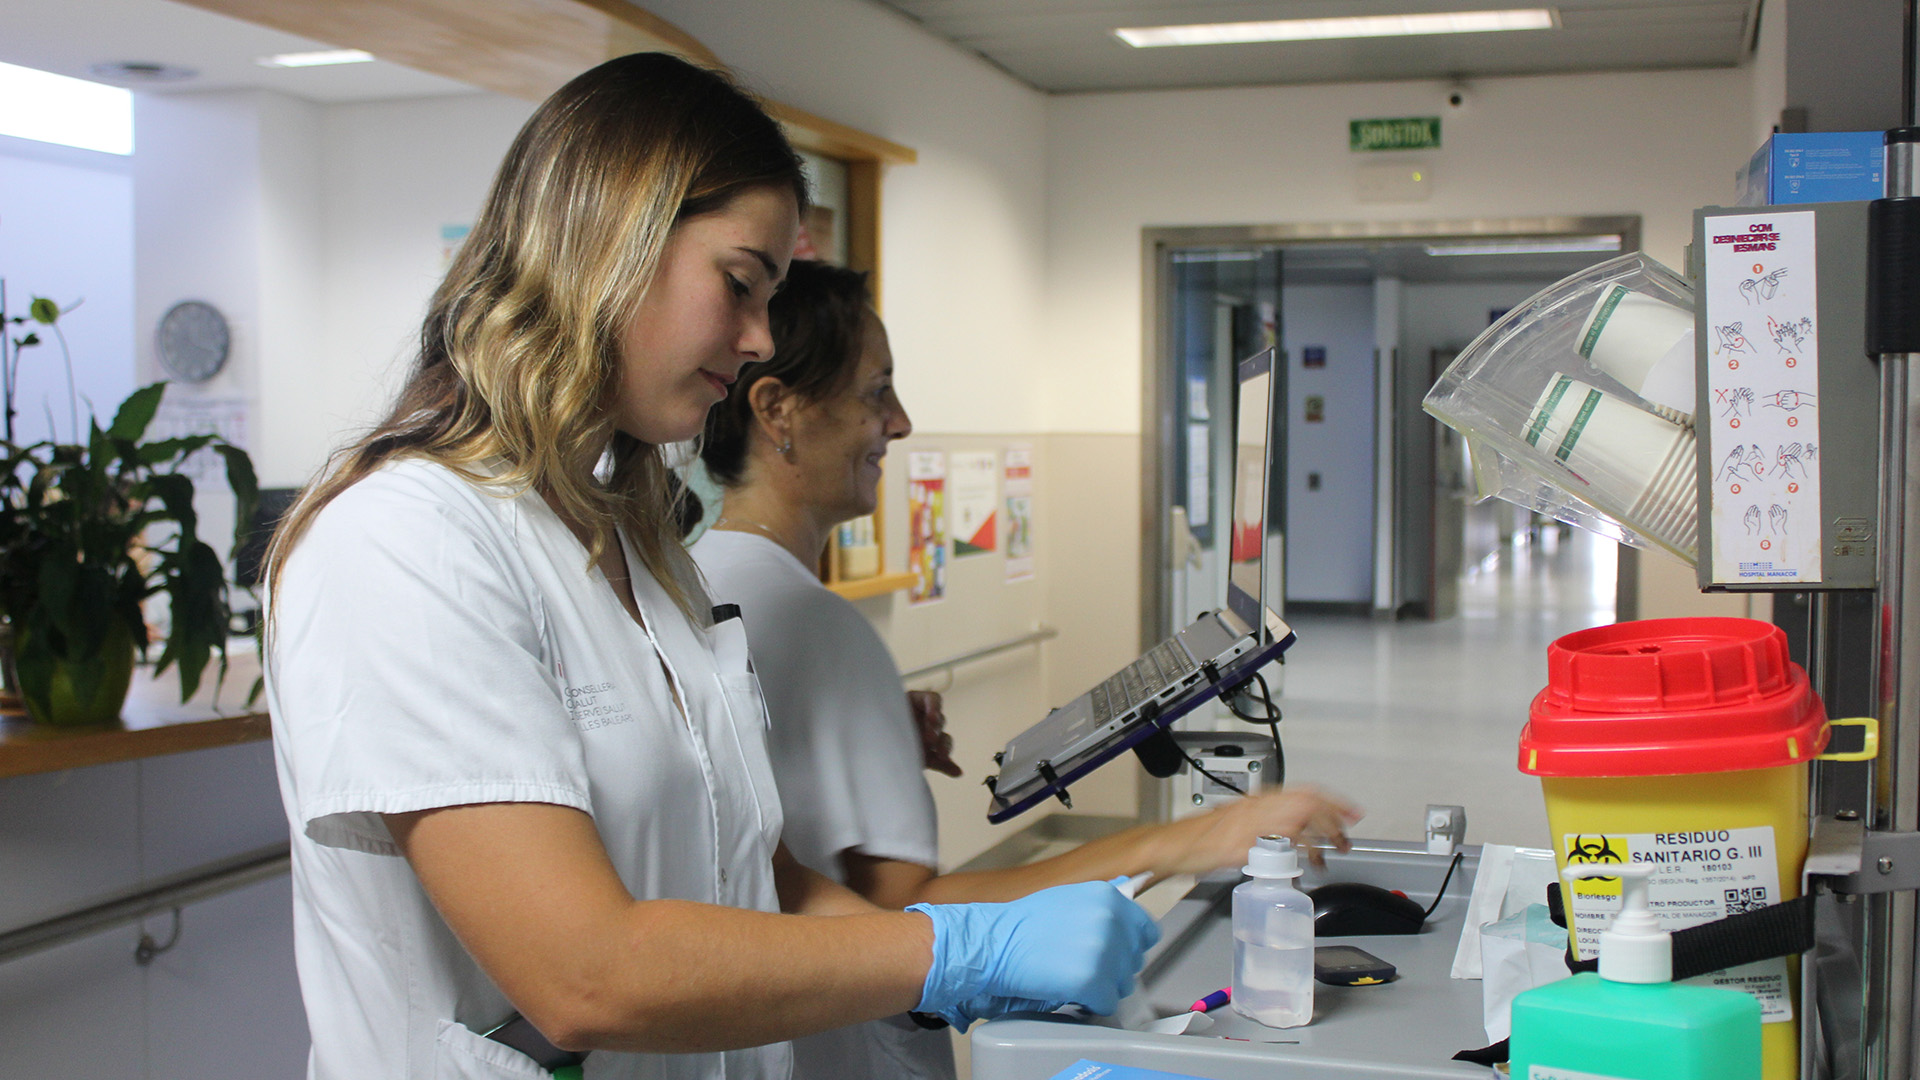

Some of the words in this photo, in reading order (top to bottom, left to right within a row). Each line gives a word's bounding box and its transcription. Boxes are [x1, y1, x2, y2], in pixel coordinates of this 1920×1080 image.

[1749, 224, 1773, 233] COM
[1656, 830, 1730, 845] RESIDUO
[1632, 848, 1721, 863] SANITARIO
[1726, 847, 1744, 860] G.
[1748, 846, 1762, 858] III
[1702, 863, 1732, 872] 180103
